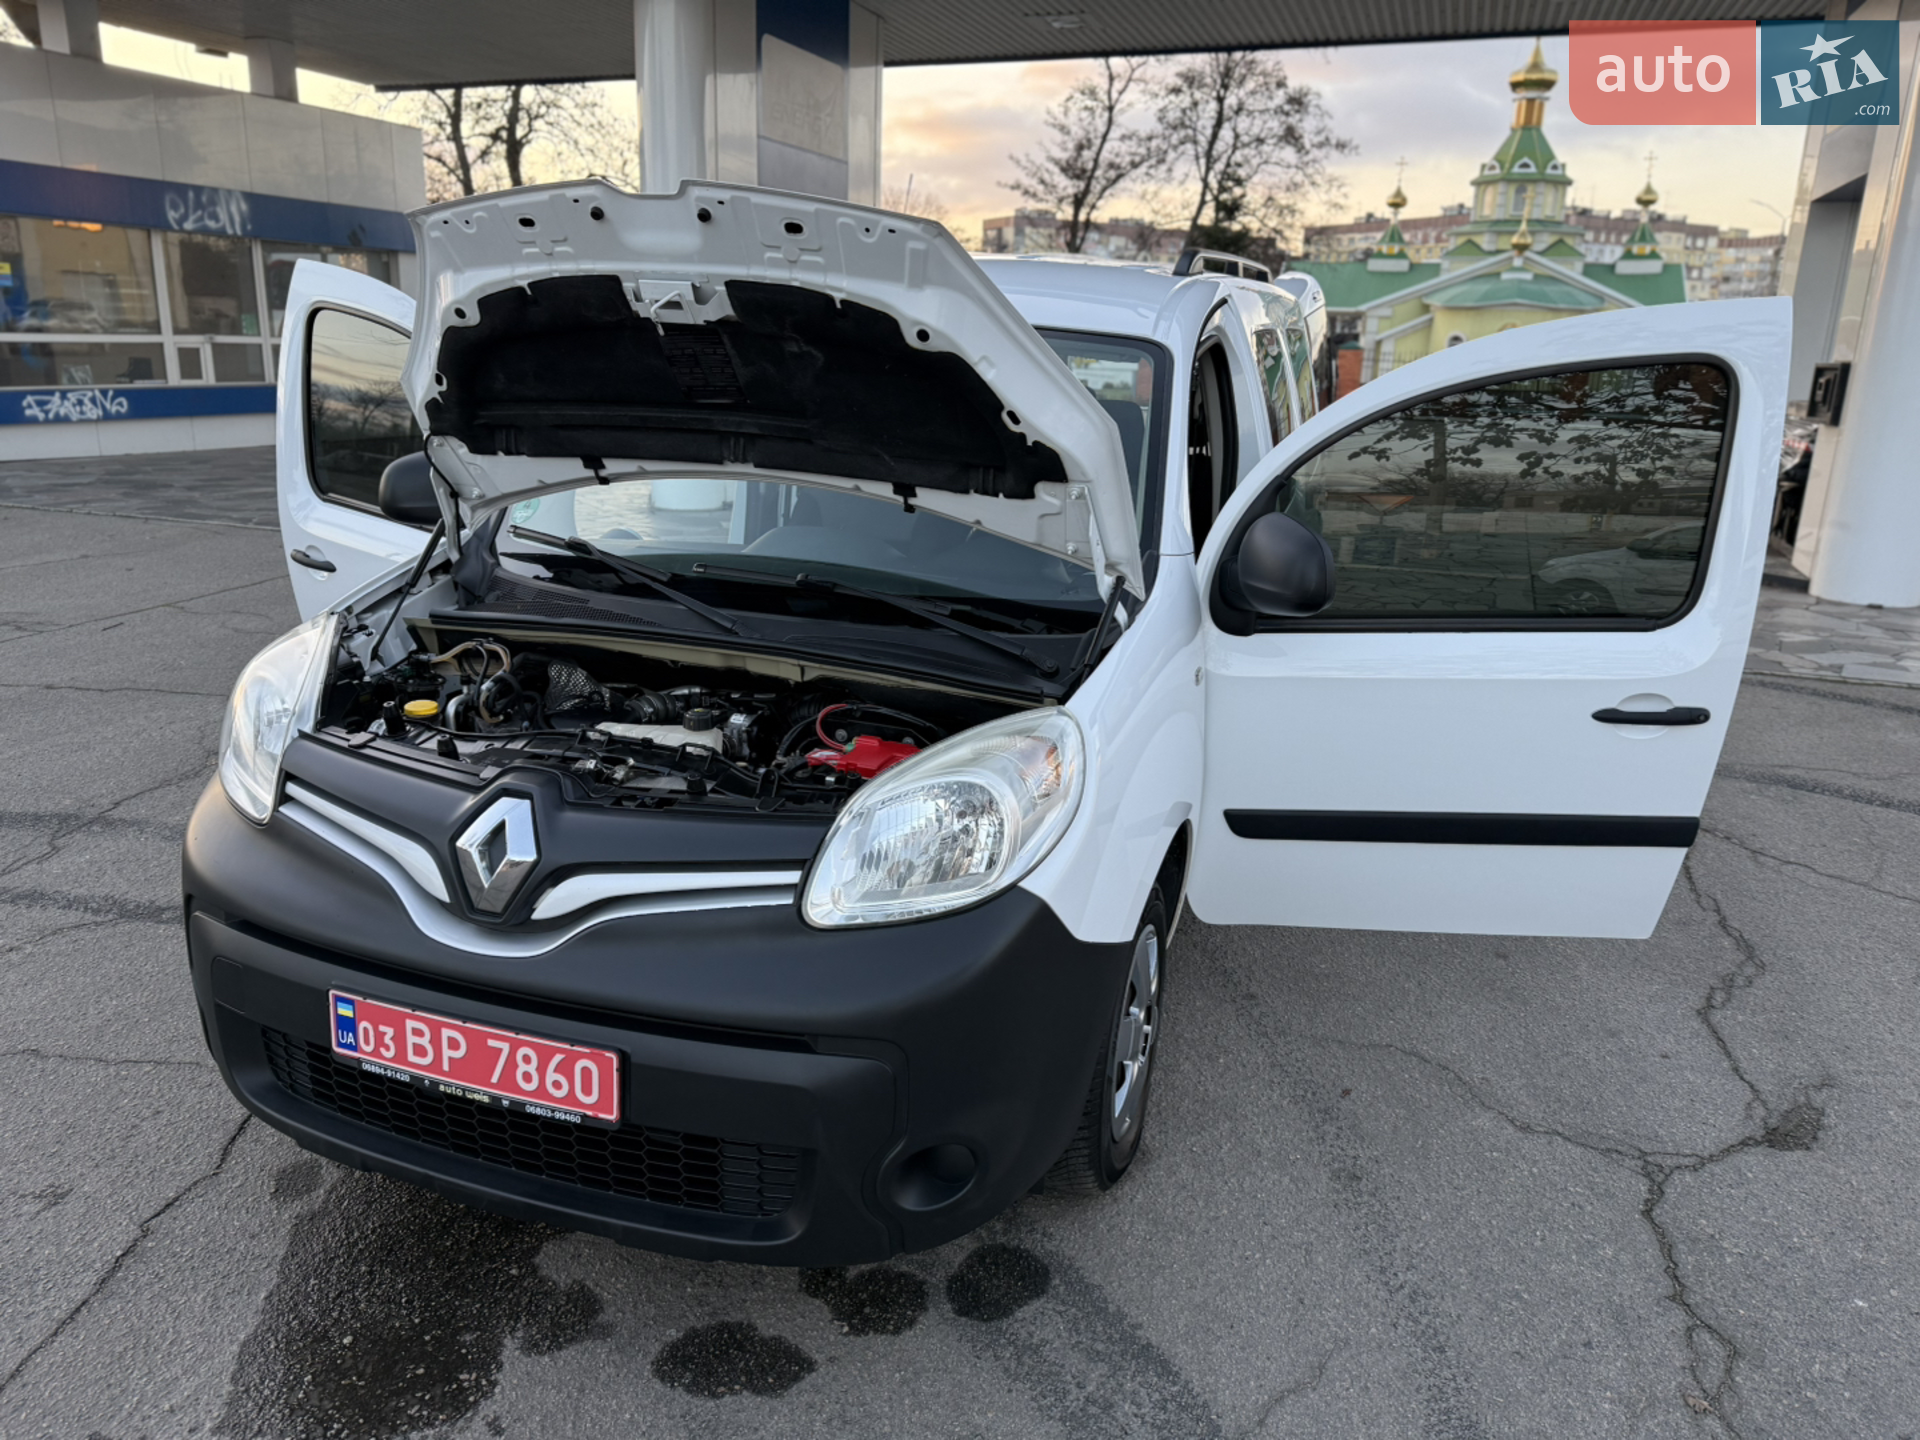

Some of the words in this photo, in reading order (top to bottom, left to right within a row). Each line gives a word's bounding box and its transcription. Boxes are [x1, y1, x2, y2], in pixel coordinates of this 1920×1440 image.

[338, 1029, 356, 1046] UA
[358, 1020, 396, 1059] 03
[405, 1018, 467, 1072] BP
[487, 1038, 599, 1105] 7860
[439, 1084, 462, 1096] auto
